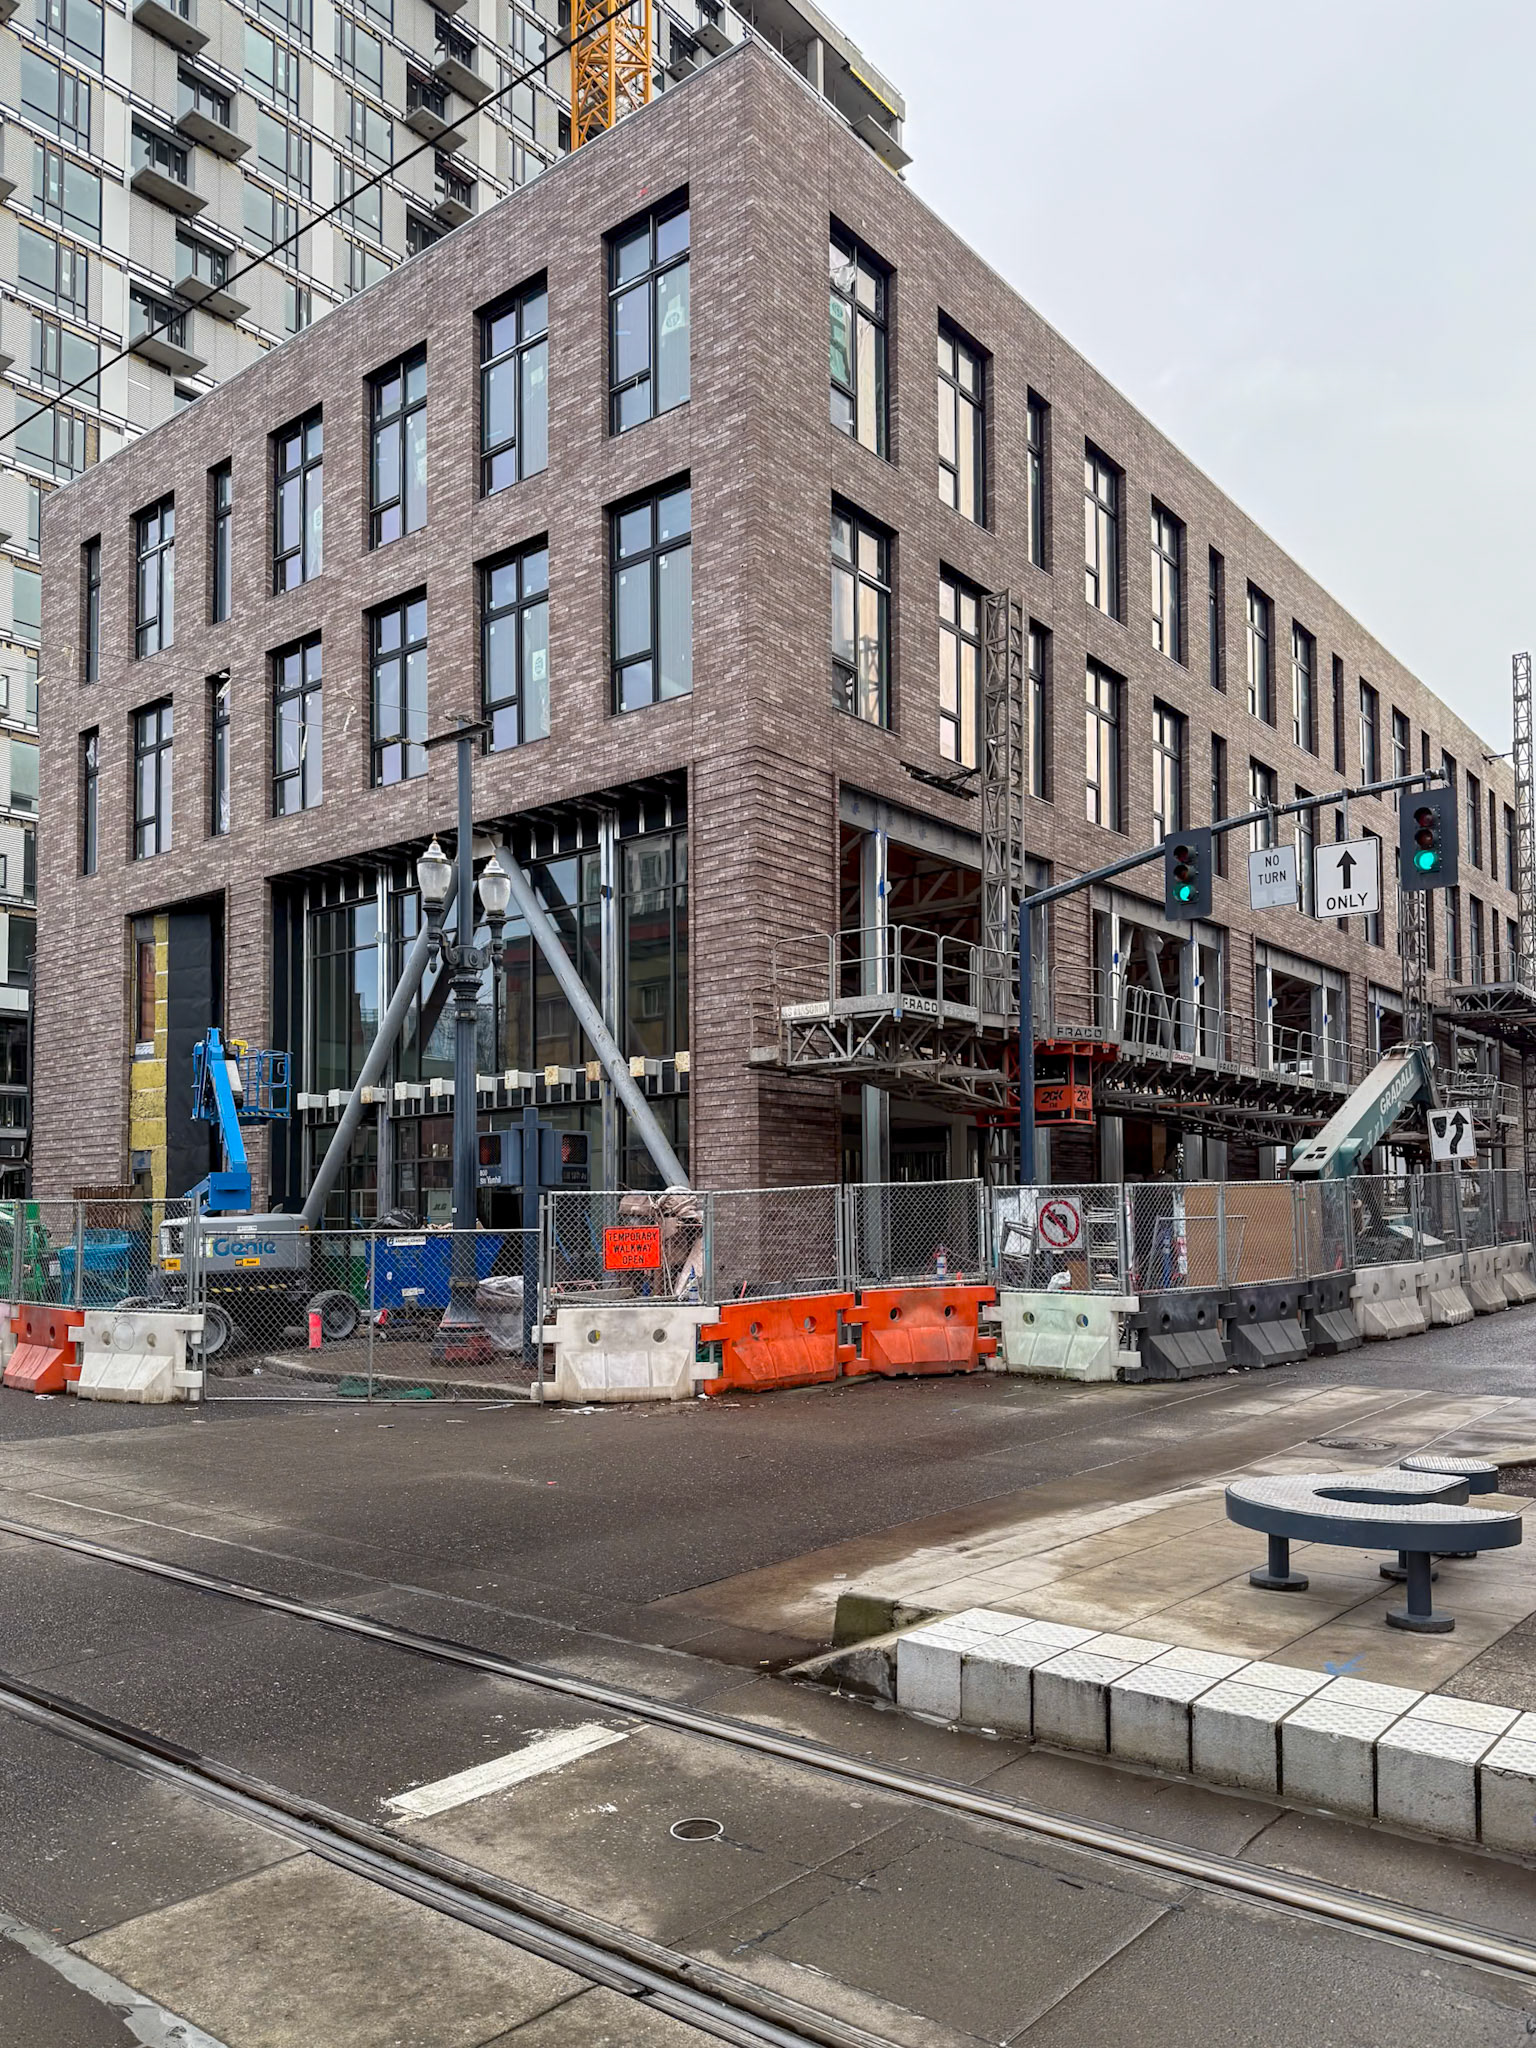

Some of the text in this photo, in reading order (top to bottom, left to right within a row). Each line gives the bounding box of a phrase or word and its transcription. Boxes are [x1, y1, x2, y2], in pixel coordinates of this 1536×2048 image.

[1265, 855, 1280, 867] NO
[1258, 870, 1287, 885] TURN
[1326, 892, 1368, 910] ONLY
[903, 997, 938, 1013] FRACO
[1057, 1027, 1102, 1038] FRACO
[1380, 1063, 1414, 1115] GRADALL
[433, 1203, 447, 1211] JLG
[608, 1232, 657, 1241] TEMPORARY
[212, 1238, 276, 1257] Genie
[614, 1244, 653, 1253] WALKWAY
[623, 1255, 644, 1265] OPEN
